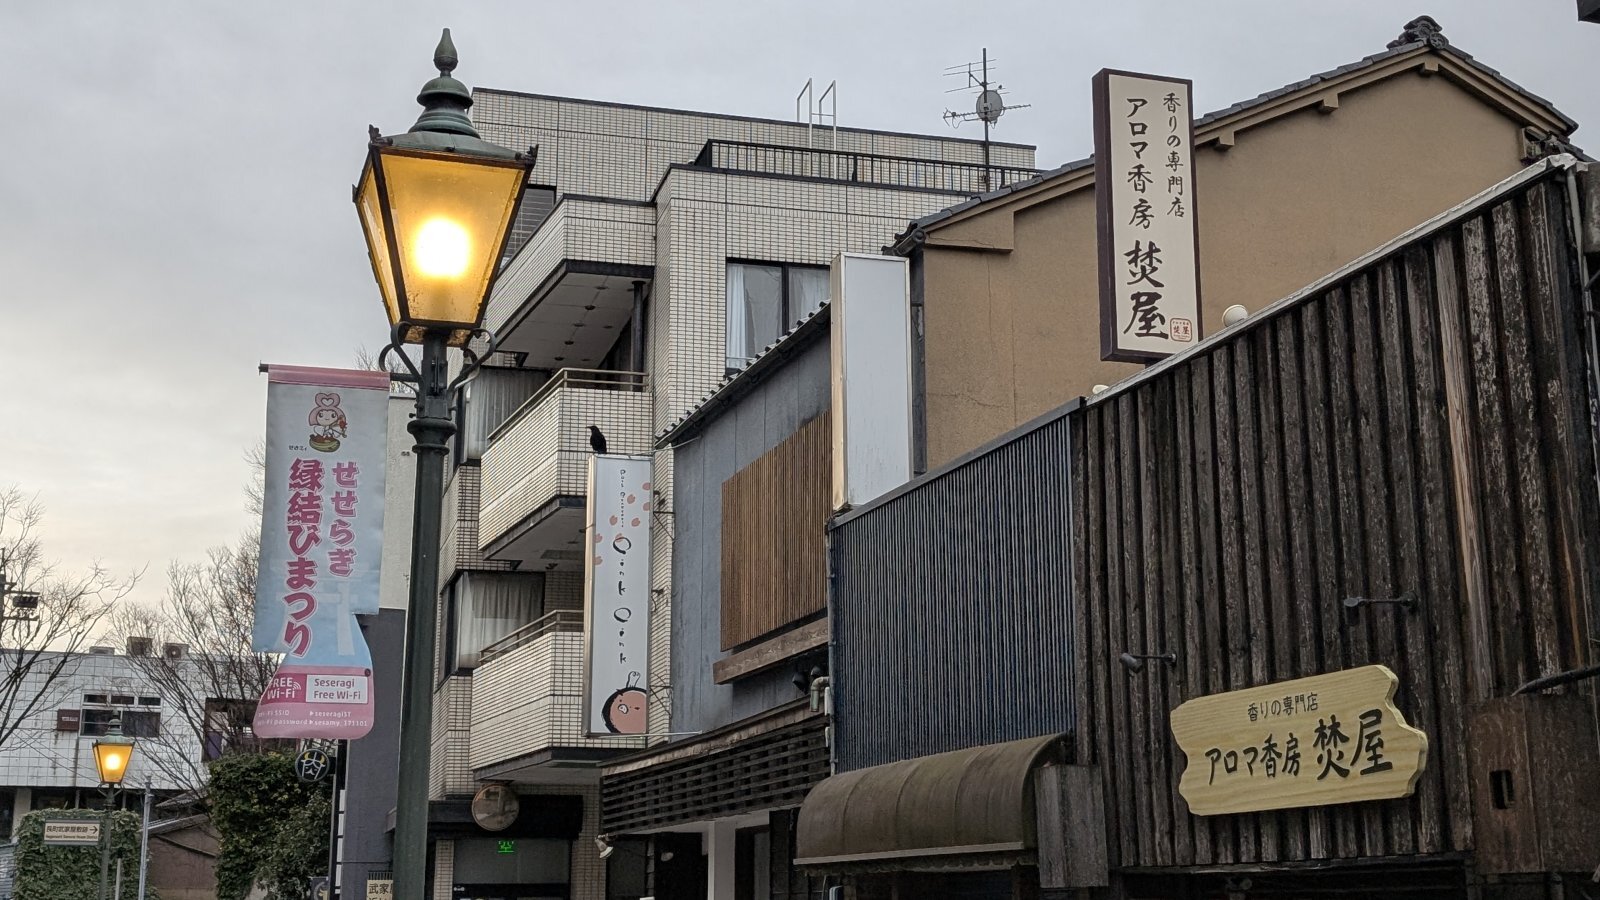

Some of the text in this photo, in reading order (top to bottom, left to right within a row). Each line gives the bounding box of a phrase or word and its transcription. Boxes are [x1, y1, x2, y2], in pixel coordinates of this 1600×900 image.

[1163, 92, 1185, 218] 香りの専門店
[1123, 97, 1169, 340] アロマ香房 焚屋
[283, 457, 325, 659] 縁結びまつり
[328, 461, 359, 578] せせらぎ
[267, 688, 295, 700] Wi-Fi
[313, 690, 361, 700] Free Wi-Fi
[314, 679, 355, 689] Seseragi
[1247, 692, 1319, 722] 香りの専門店
[1205, 708, 1393, 786] アロマ香房 焚屋
